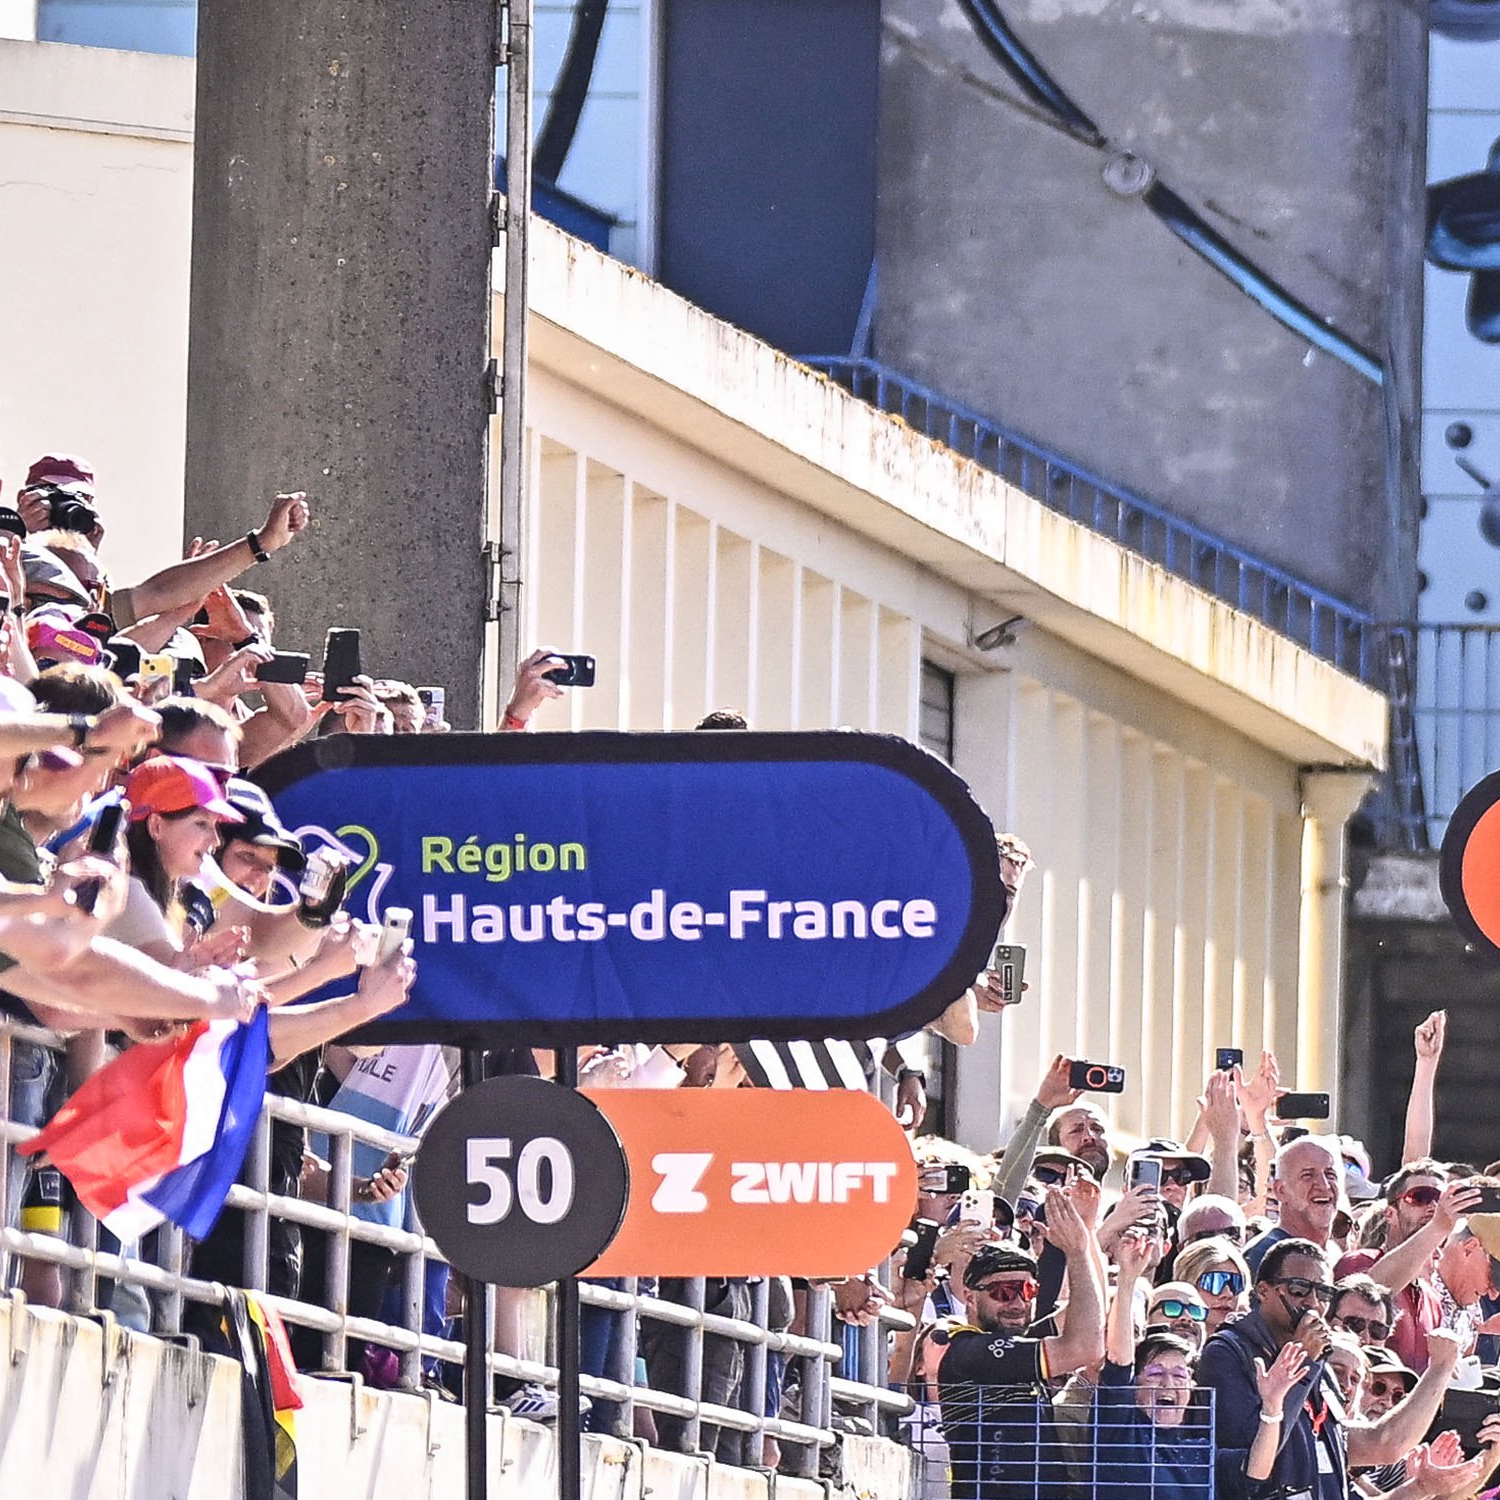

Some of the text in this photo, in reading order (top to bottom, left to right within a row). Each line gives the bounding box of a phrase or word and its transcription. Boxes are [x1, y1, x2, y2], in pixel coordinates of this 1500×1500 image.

[421, 834, 587, 882] Région
[422, 888, 937, 944] Hauts-de-France
[465, 1137, 573, 1225] 50
[730, 1162, 897, 1204] ZWIFT
